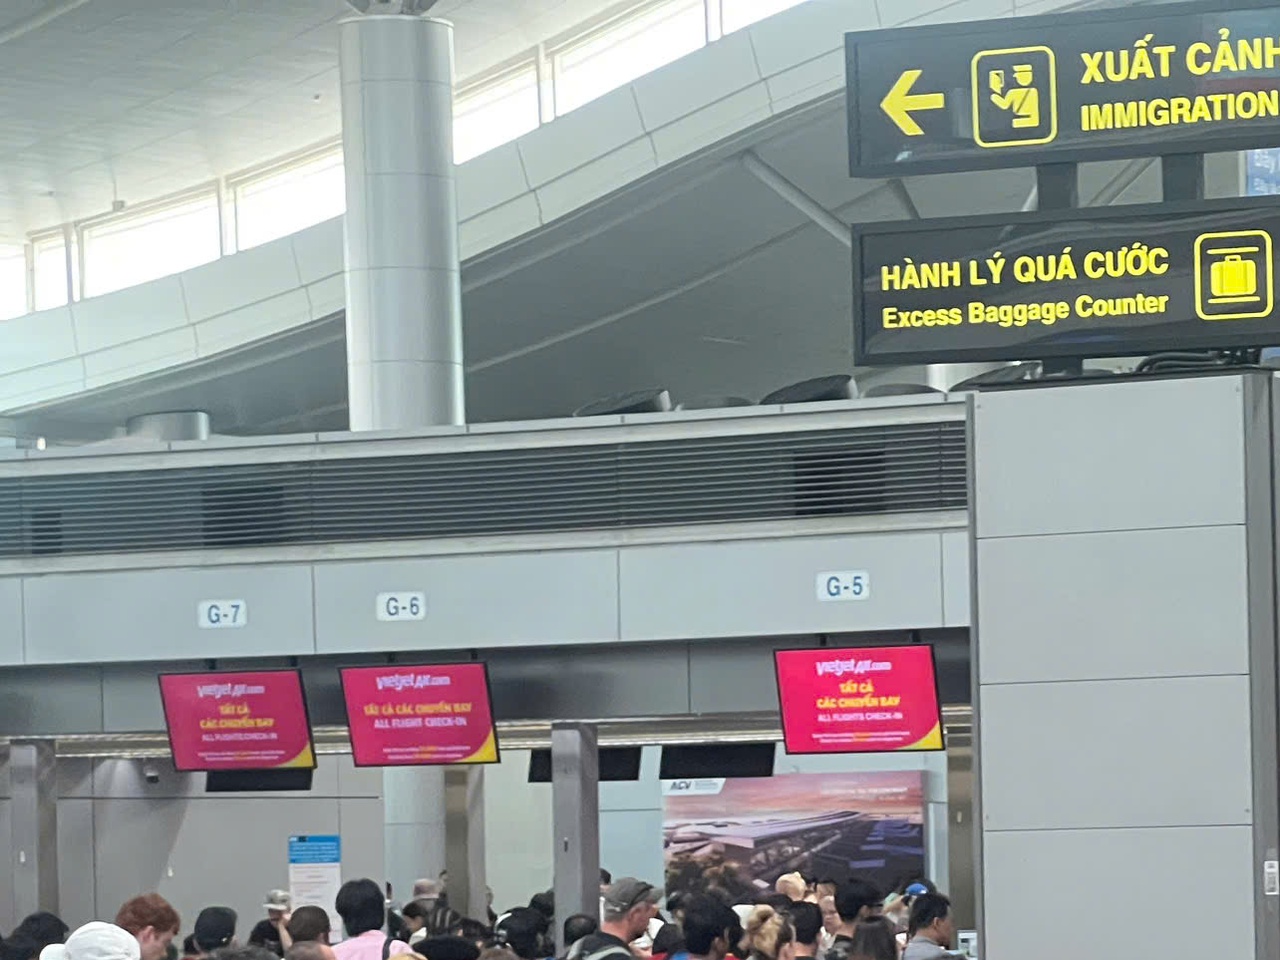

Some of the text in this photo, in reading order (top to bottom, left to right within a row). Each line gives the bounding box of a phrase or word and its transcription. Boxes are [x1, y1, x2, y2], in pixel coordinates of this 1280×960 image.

[1081, 34, 1176, 83] XUẤT
[1081, 90, 1280, 131] IMMIGRATION
[881, 242, 1170, 291] HÀNH LÝ QUÁ CƯỚC
[882, 293, 1169, 328] Excess Baggage Counter
[826, 575, 863, 597] G-5
[207, 604, 240, 624] G-7
[385, 596, 420, 617] G-6
